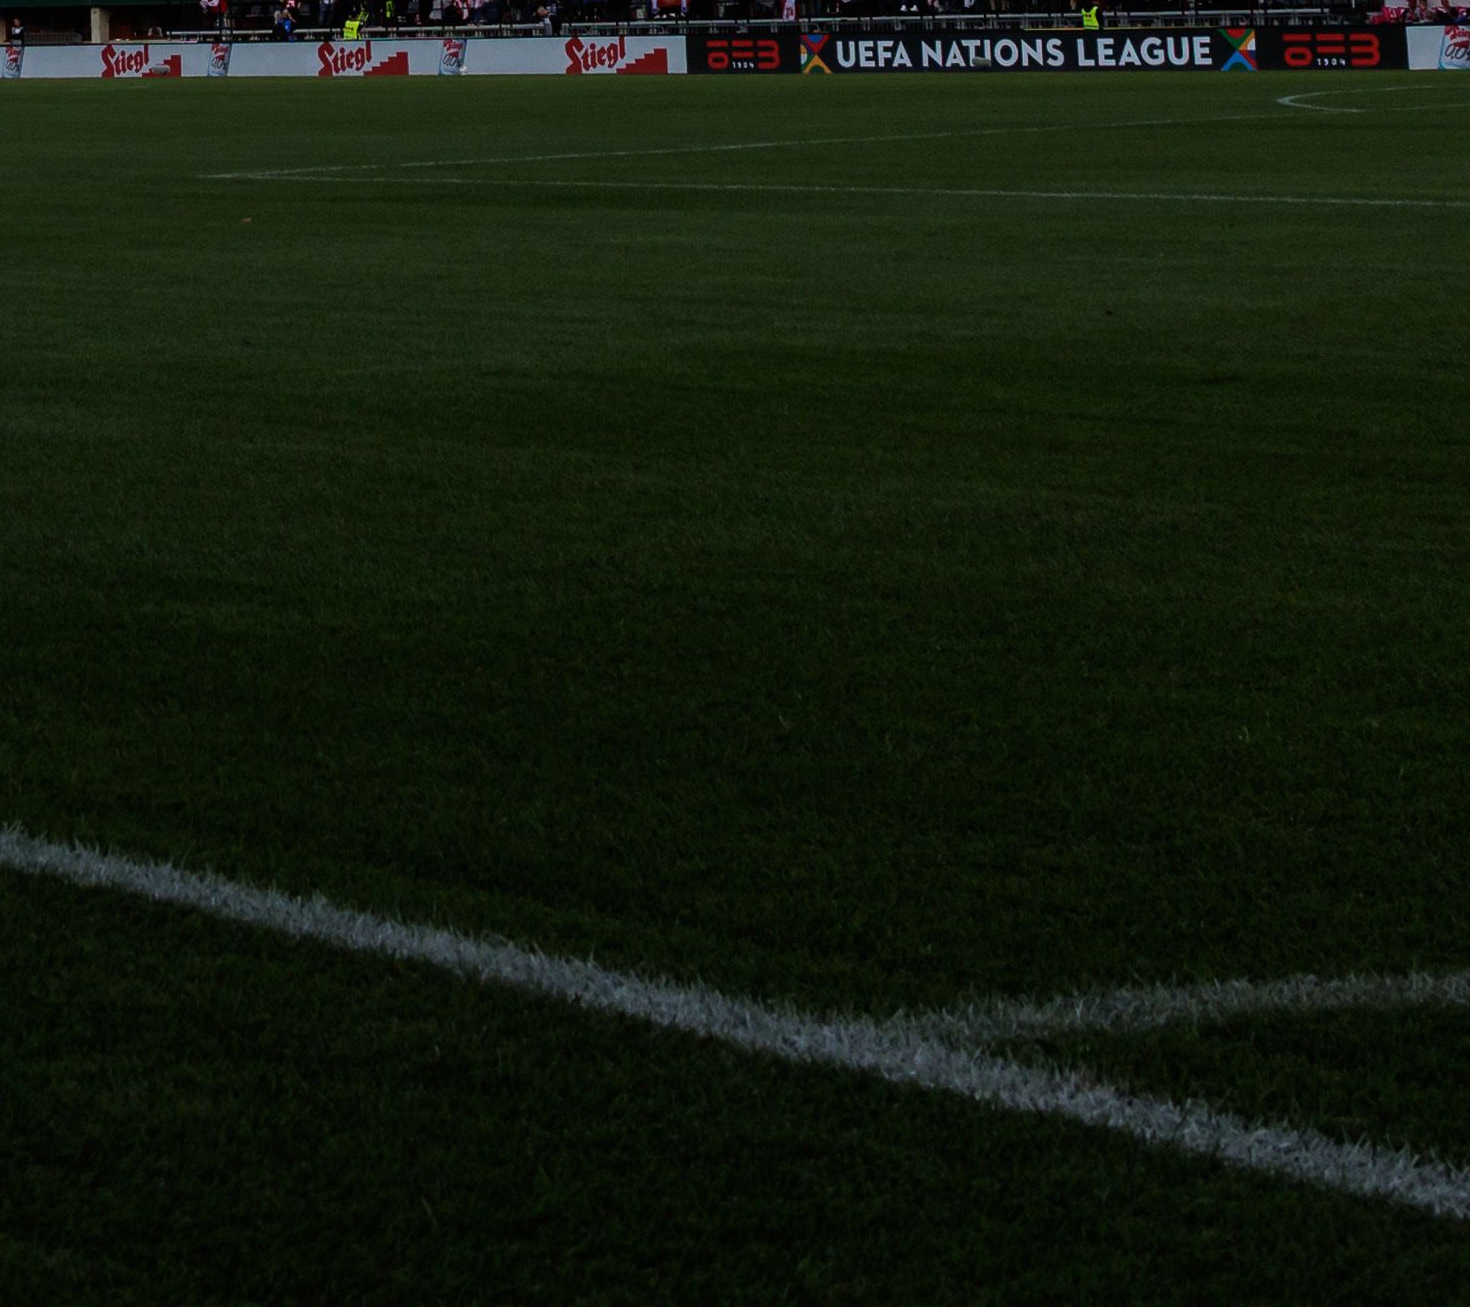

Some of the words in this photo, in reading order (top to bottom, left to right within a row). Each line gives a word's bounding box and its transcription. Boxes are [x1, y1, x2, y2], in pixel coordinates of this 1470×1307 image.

[101, 43, 149, 78] Stiegl
[318, 38, 372, 77] Stiegl
[565, 34, 626, 75] Stiegl
[835, 38, 913, 69] UEFA
[920, 37, 1065, 68] NATIONS
[1076, 35, 1213, 67] LEAGUE
[1316, 58, 1347, 67] 1904
